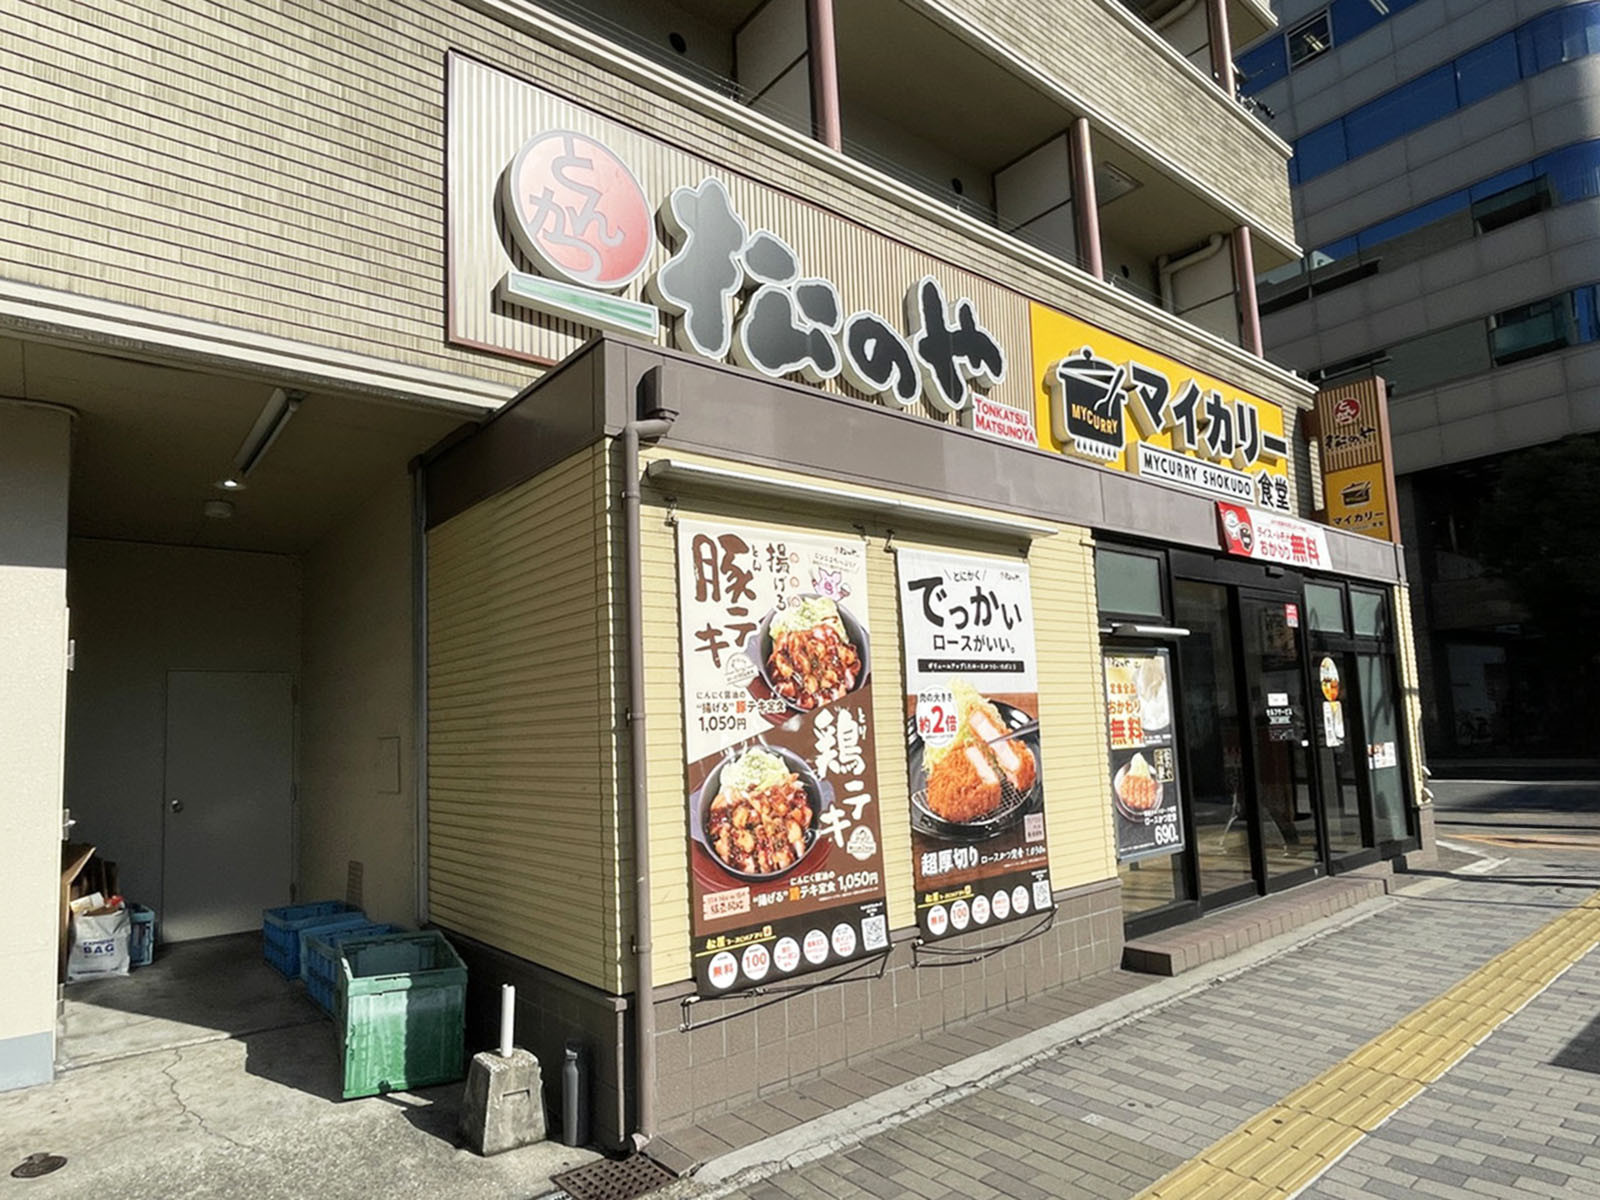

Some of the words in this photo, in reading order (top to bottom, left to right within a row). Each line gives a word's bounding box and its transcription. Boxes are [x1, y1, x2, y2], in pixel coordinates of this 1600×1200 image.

[526, 135, 626, 283] とんかつ
[658, 177, 1006, 412] 松のや
[975, 397, 1028, 427] TONKATSU
[1071, 403, 1118, 435] MYCURRY
[1130, 361, 1288, 464] マイカリー
[975, 414, 1036, 444] MATSUNOYA
[1144, 453, 1198, 481] MYCURRY
[1203, 470, 1252, 496] SHOKUDO
[1257, 471, 1290, 511] 食堂
[1333, 511, 1385, 525] マイカリー
[766, 543, 790, 611] 揚げる
[907, 576, 1023, 630] でっかい
[933, 634, 1016, 654] ロースがいい。
[698, 715, 747, 733] 1,050円
[919, 705, 958, 734] 約2倍
[1110, 717, 1144, 745] 無料
[921, 845, 979, 878] 超厚切り
[837, 871, 879, 892] 1,050円
[83, 943, 115, 954] BAG
[745, 952, 767, 969] 100
